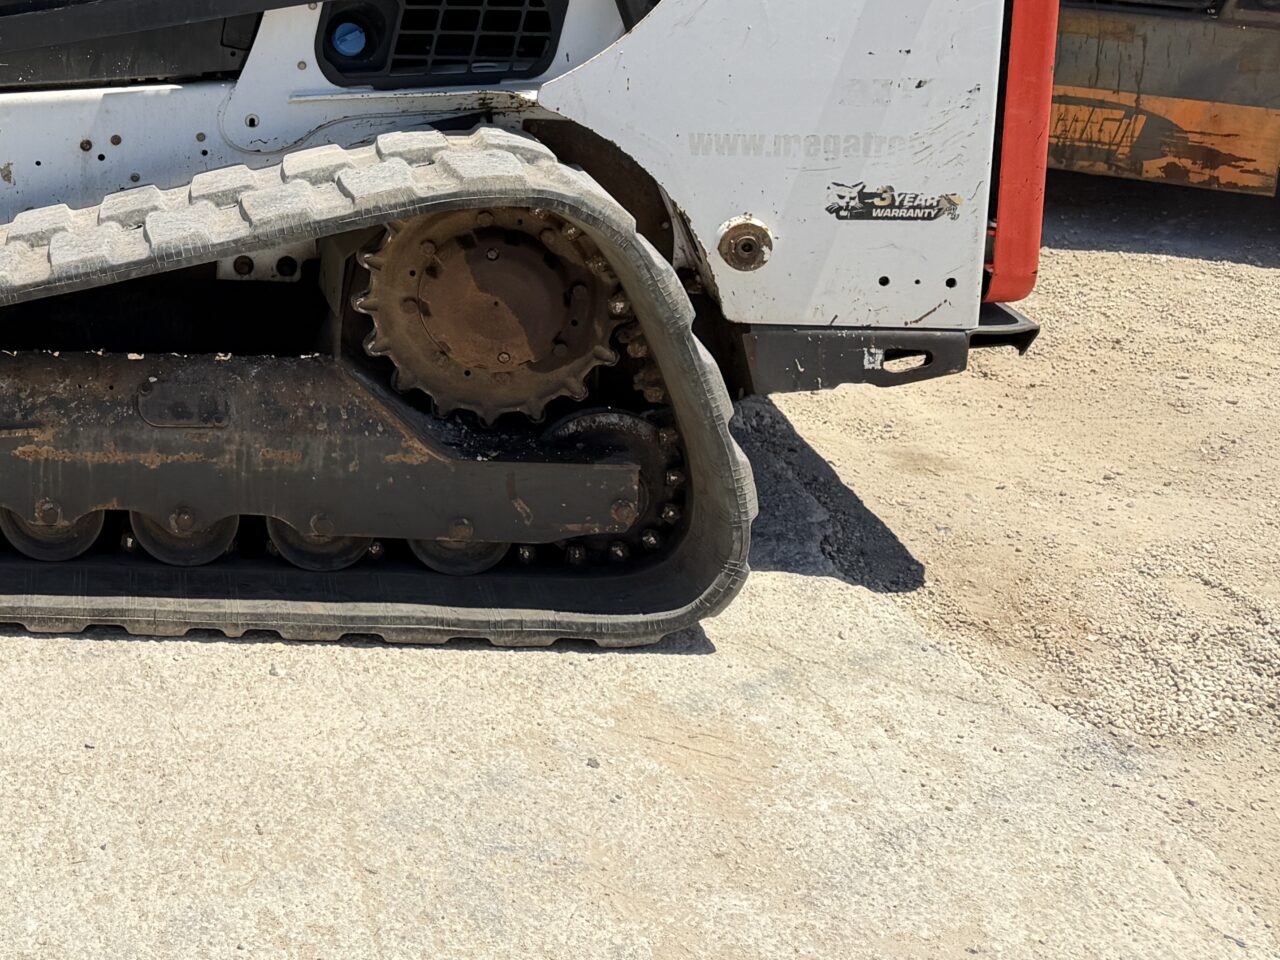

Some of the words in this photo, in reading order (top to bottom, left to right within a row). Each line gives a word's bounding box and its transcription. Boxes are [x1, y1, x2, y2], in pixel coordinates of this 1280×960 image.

[873, 185, 895, 207] 3
[894, 193, 940, 207] YEAR
[872, 208, 938, 218] WARRANTY
